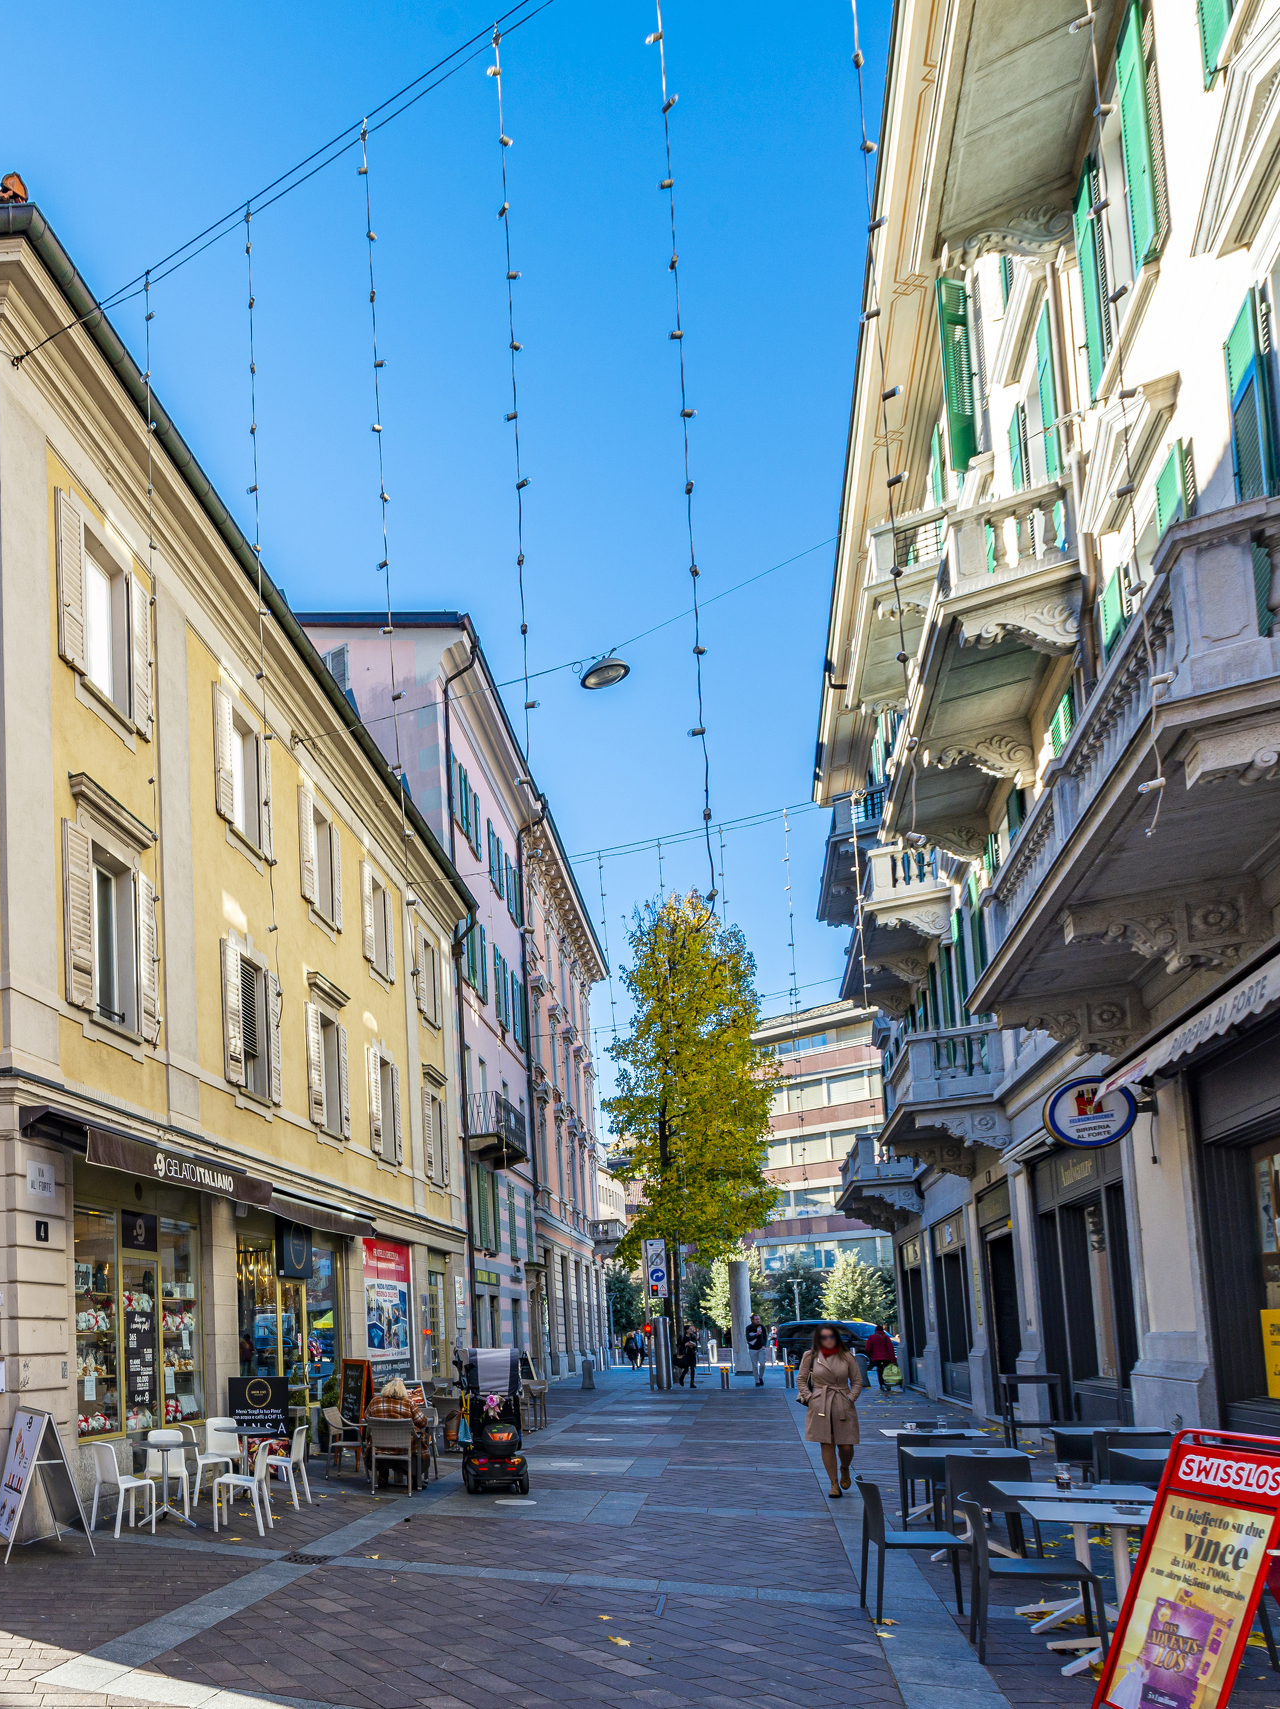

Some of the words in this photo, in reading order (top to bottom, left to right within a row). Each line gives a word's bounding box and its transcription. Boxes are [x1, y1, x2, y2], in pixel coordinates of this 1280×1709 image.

[1213, 1002, 1229, 1027] AL
[1228, 976, 1268, 1018] FORTE
[1075, 1123, 1111, 1134] BIRRERIA
[1087, 1129, 1112, 1138] FORTE
[38, 1180, 52, 1193] FORTE
[40, 1223, 45, 1239] 4
[1178, 1454, 1280, 1495] SWISSLOS
[1170, 1504, 1185, 1520] Un
[1185, 1507, 1230, 1531] biglietto
[1231, 1521, 1244, 1535] su
[1245, 1521, 1266, 1539] due
[1184, 1526, 1249, 1571] vince
[1170, 1556, 1180, 1567] da
[1164, 1570, 1182, 1582] altro
[1181, 1573, 1211, 1591] biglietto
[1163, 1622, 1179, 1634] DAS
[1147, 1629, 1203, 1655] ADVENTS-
[1153, 1646, 1188, 1673] LOS
